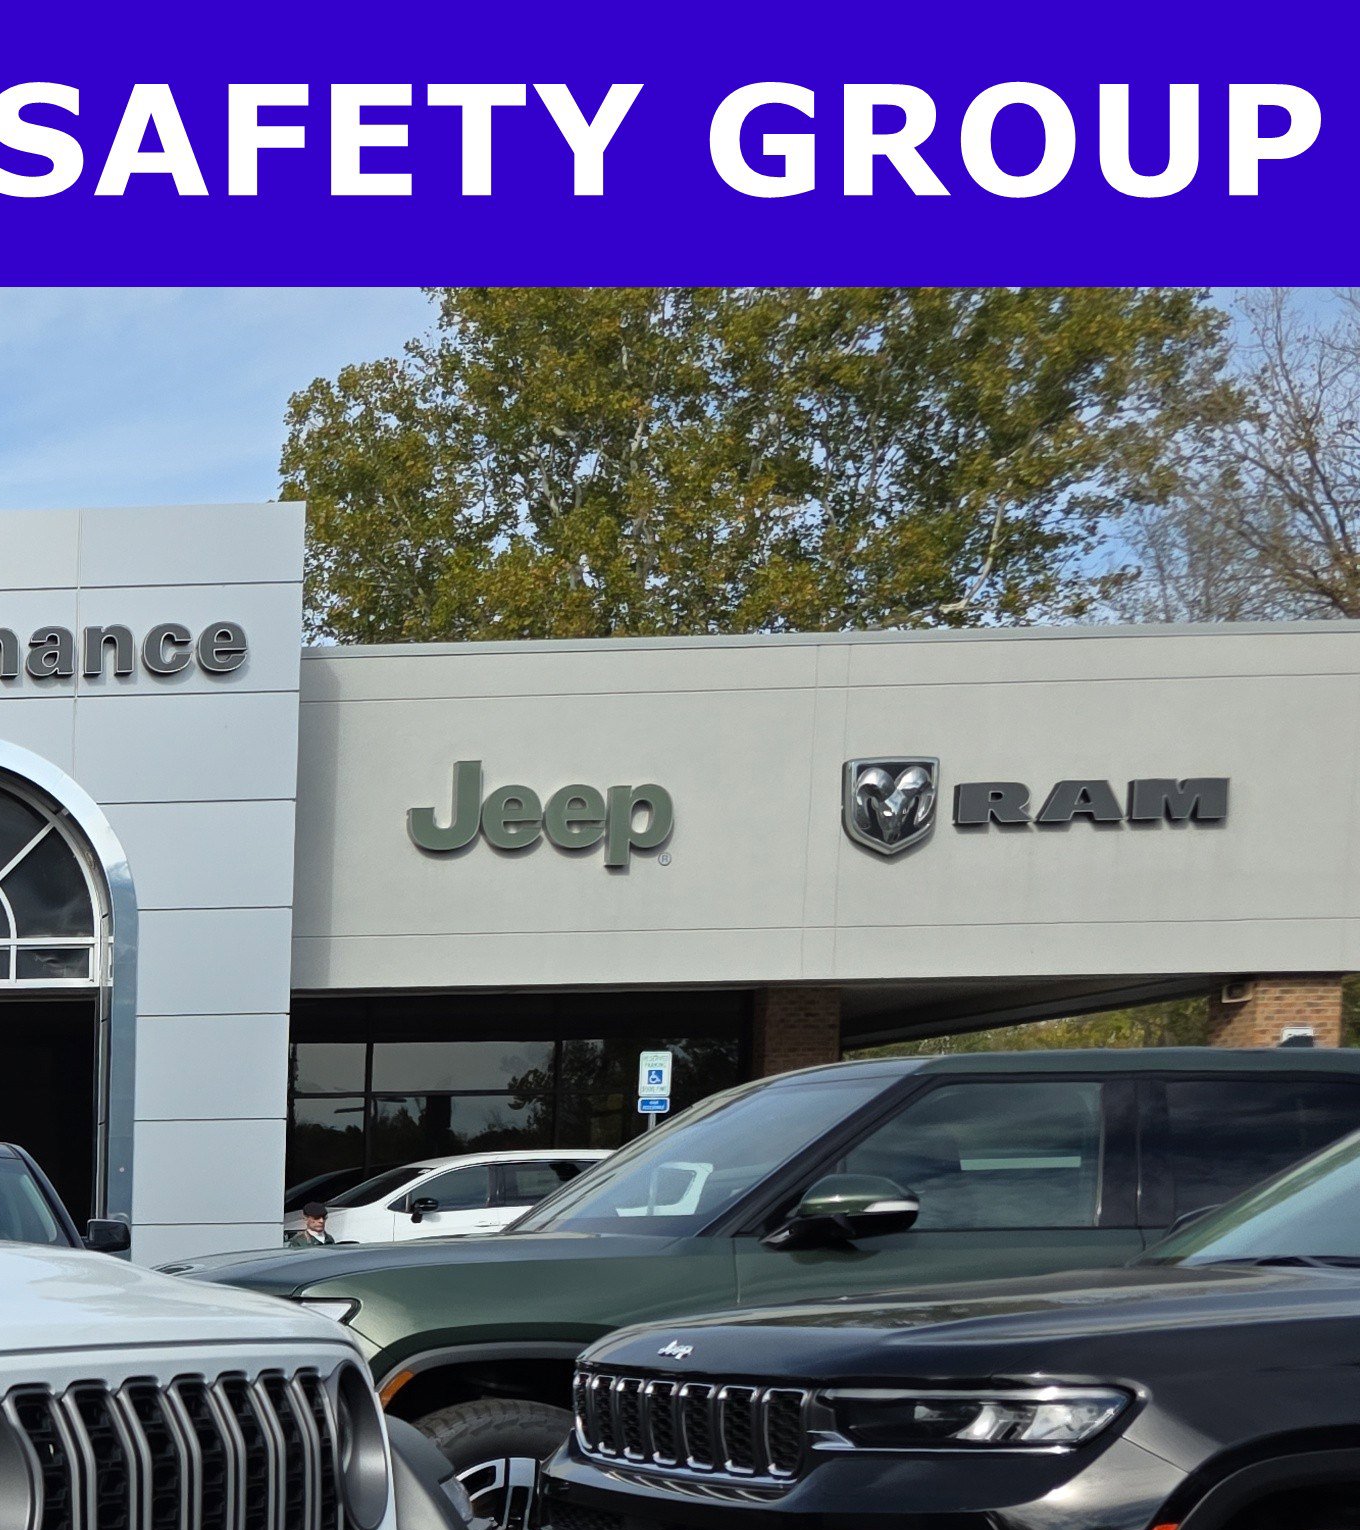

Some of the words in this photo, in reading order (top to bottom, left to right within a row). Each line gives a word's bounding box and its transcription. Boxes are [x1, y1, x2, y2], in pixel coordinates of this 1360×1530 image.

[406, 759, 675, 867] Jeep
[953, 776, 1231, 830] RAM
[657, 1340, 694, 1360] Jeep
